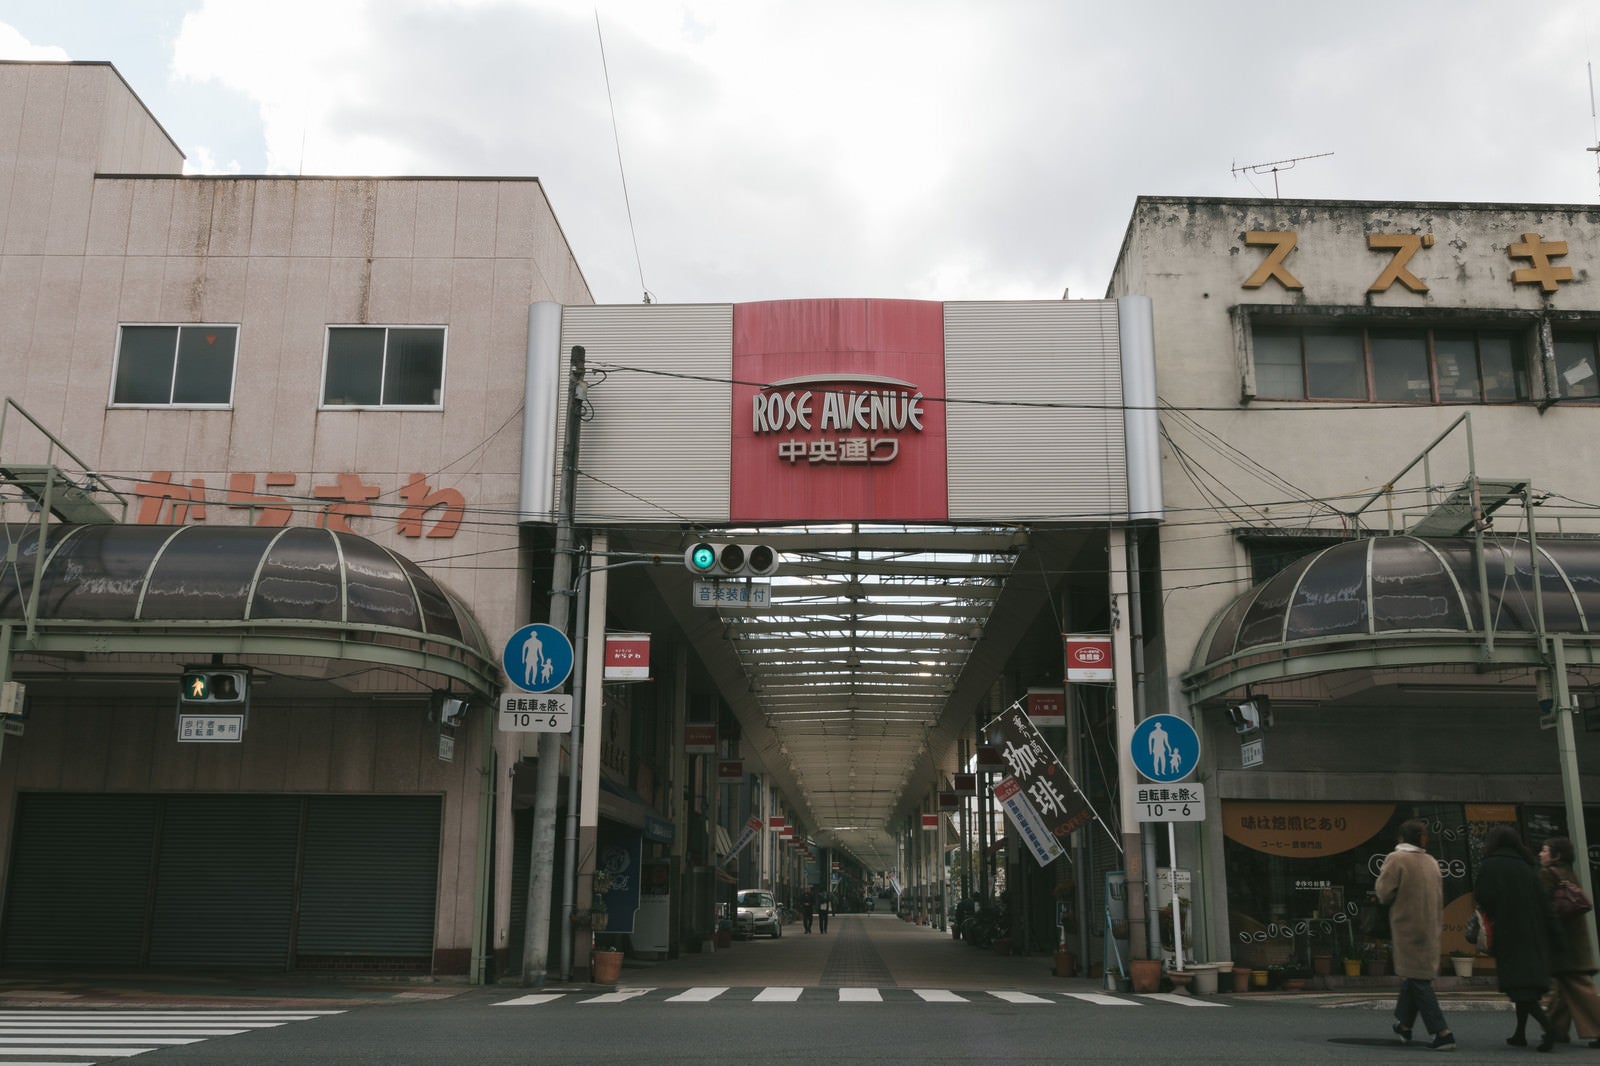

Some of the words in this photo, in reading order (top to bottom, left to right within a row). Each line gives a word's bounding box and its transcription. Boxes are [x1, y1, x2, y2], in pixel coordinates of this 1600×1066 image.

[1242, 231, 1573, 293] スズキ
[753, 391, 812, 432] ROSE
[821, 391, 924, 431] AVENUE
[779, 437, 899, 462] 中央通り
[134, 470, 465, 538] からさわ
[699, 587, 766, 602] 音楽装置付
[506, 699, 567, 711] 自転車を除く
[1002, 741, 1068, 818] 珈琲
[1138, 788, 1198, 801] 自転車を除く
